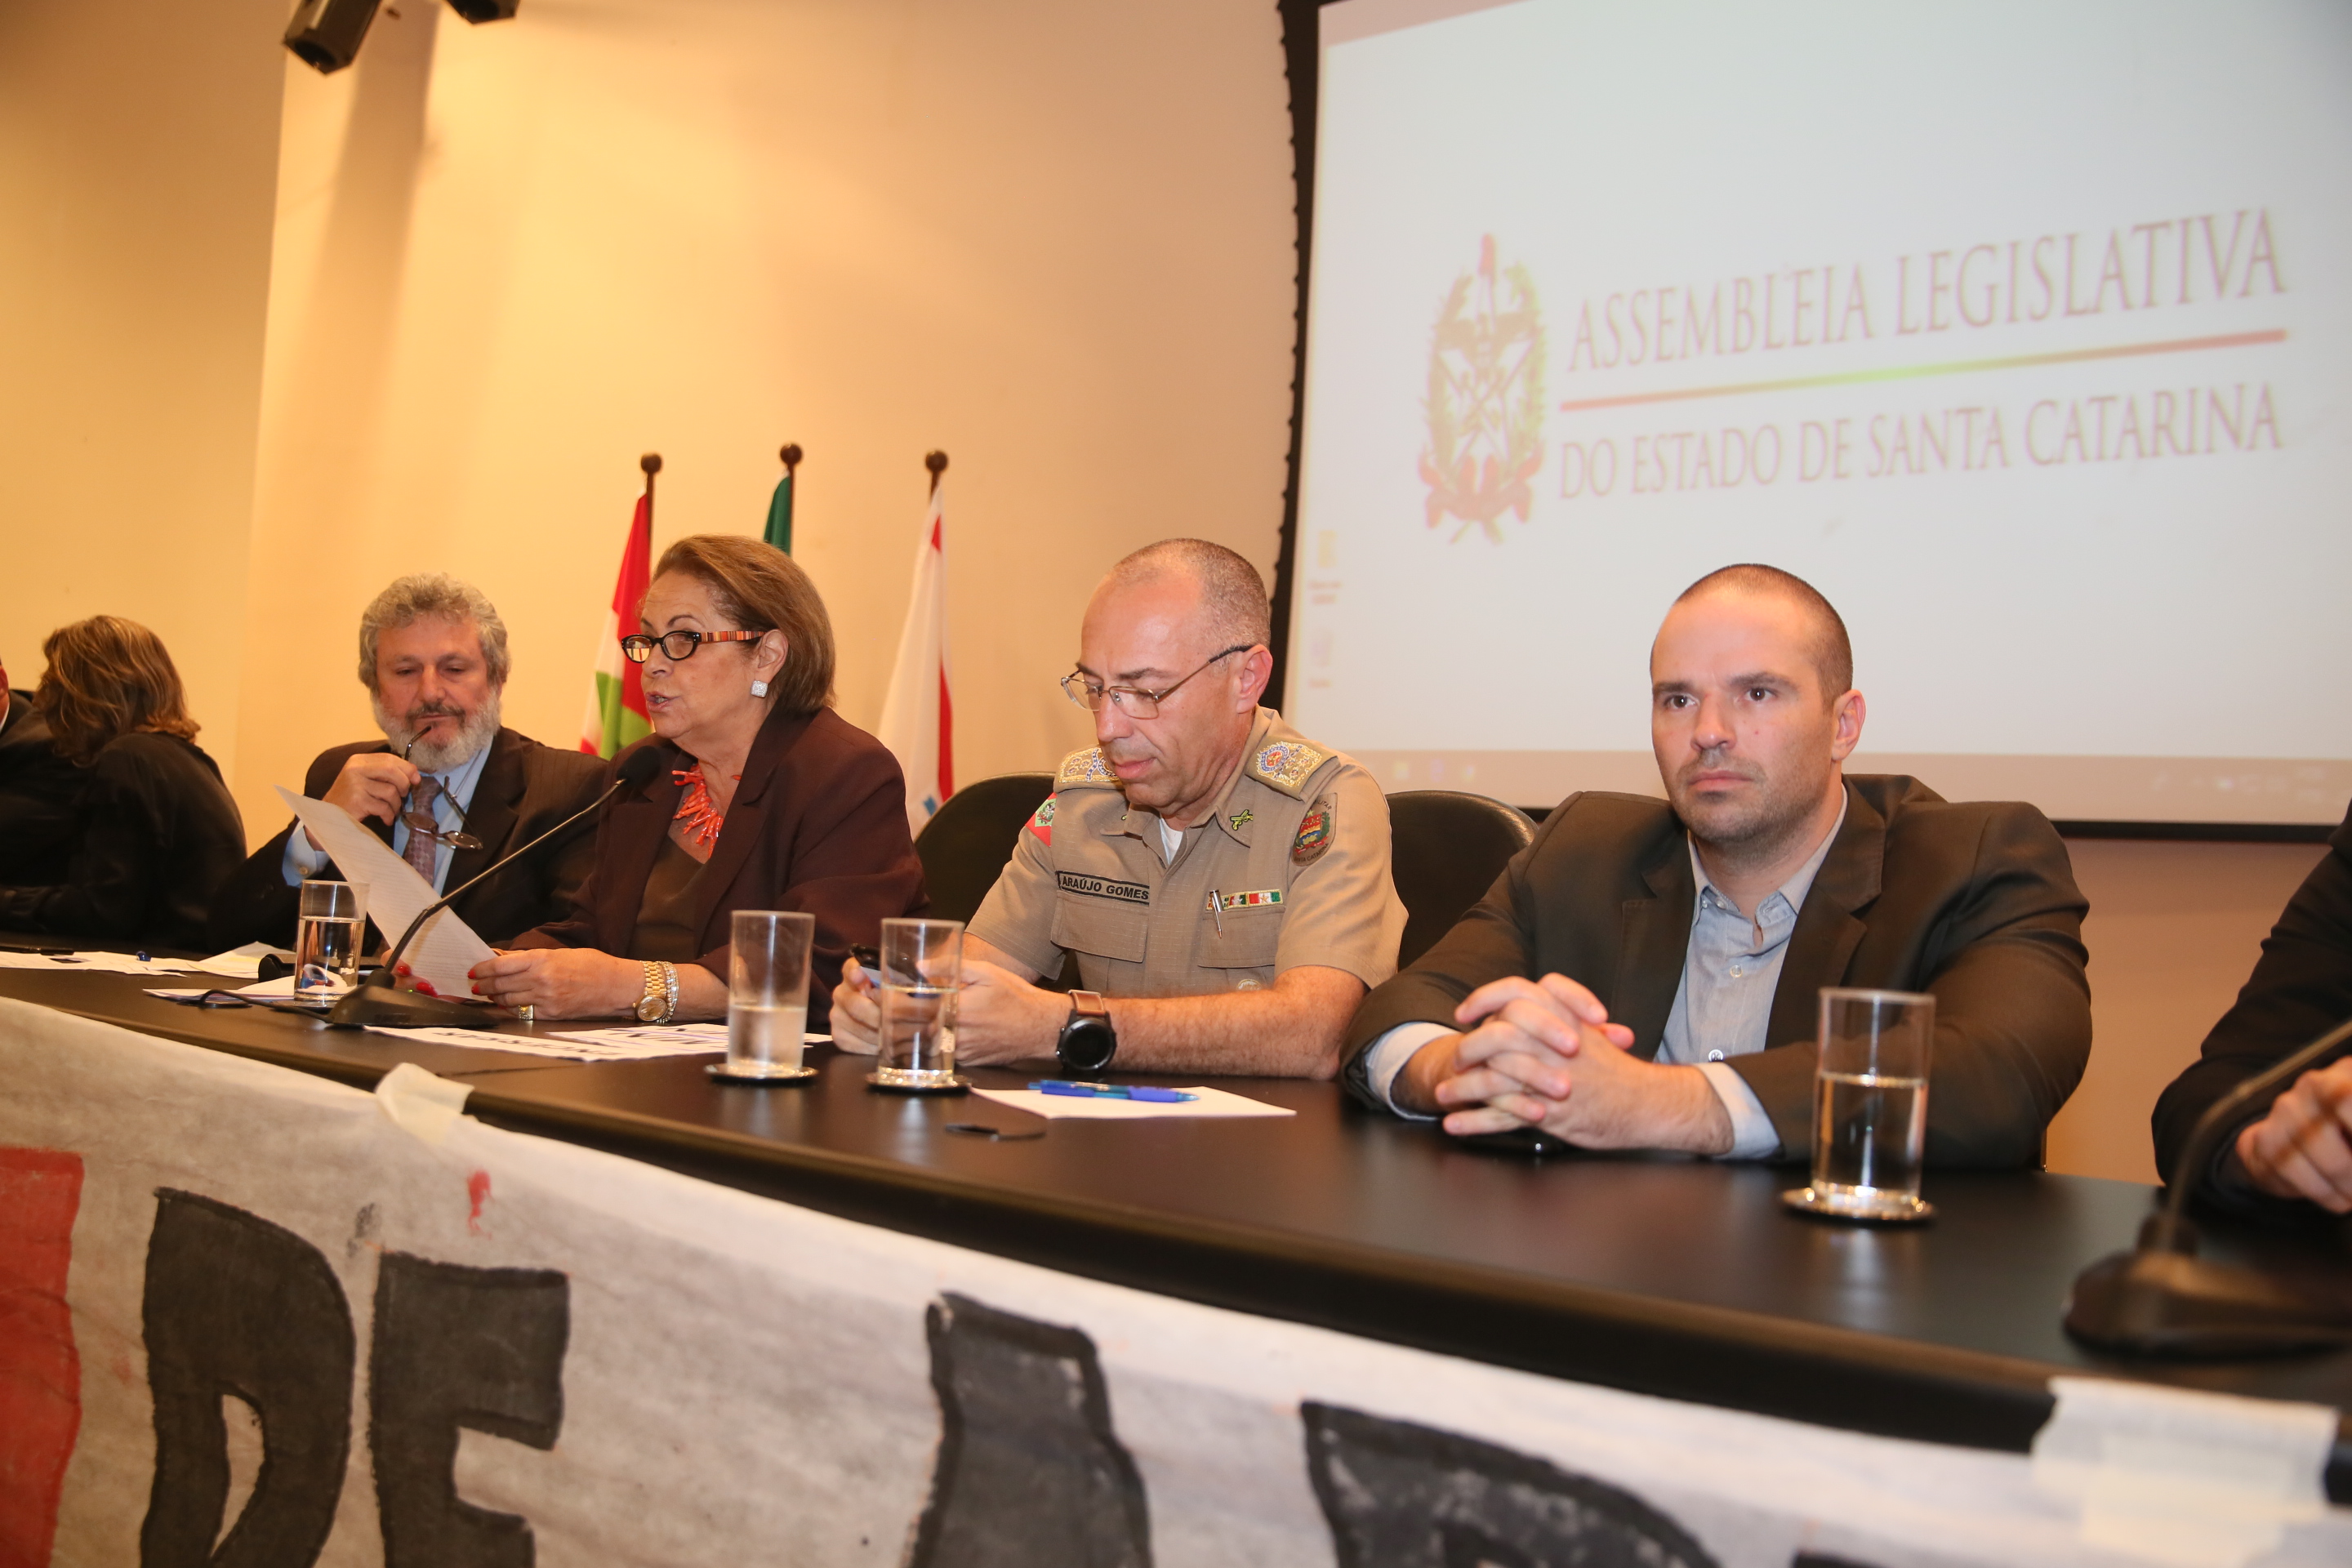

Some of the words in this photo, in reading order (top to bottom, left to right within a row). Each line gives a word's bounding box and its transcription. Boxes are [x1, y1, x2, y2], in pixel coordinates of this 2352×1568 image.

[1895, 206, 2288, 336] LEGISLATIVA
[1559, 438, 1616, 501] DO
[1630, 422, 1782, 494] ESTADO
[1800, 416, 1852, 482] DE
[1867, 406, 2011, 478] SANTA
[2025, 381, 2286, 469] CATARINA
[1062, 876, 1102, 893] ARAÚJO
[1106, 884, 1149, 900] GOMES
[1307, 843, 1330, 862] CATARINA
